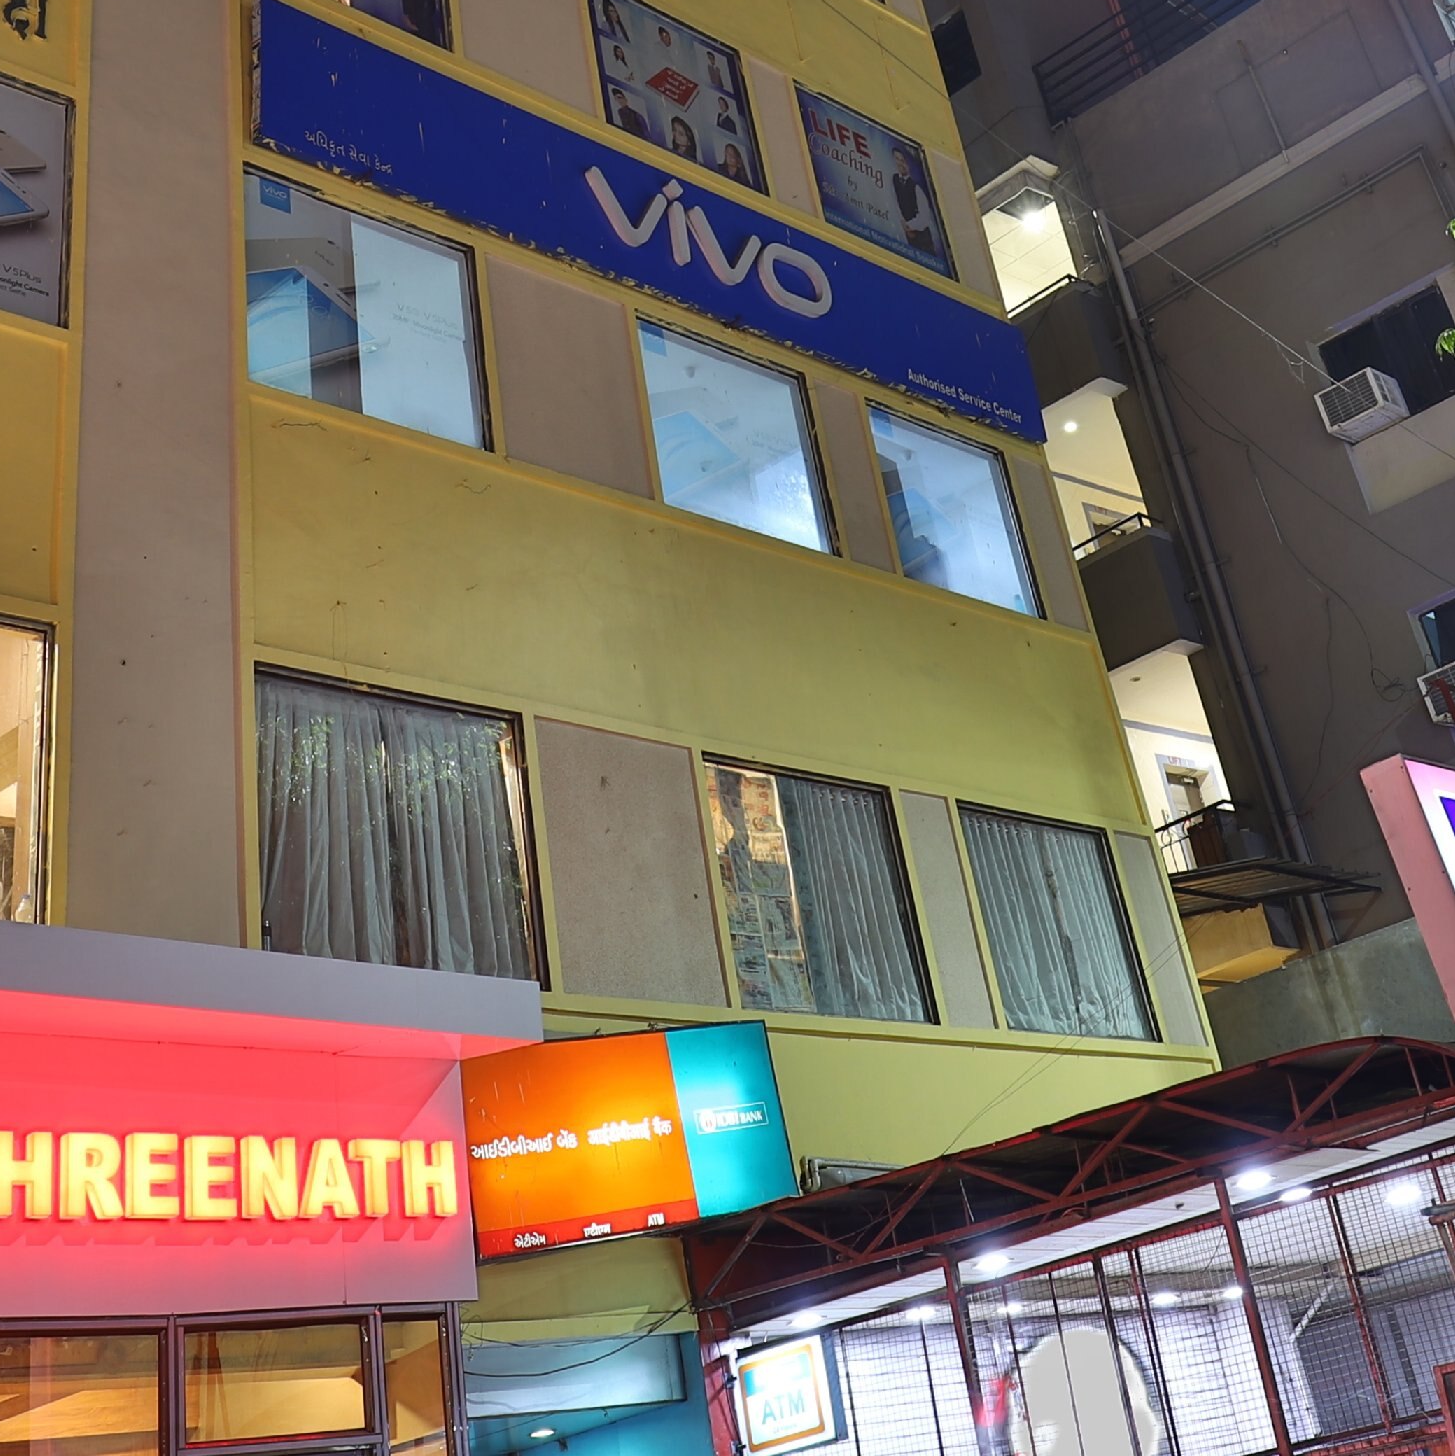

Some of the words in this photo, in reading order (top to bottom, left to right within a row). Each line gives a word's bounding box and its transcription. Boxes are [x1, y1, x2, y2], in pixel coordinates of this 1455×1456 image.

[809, 108, 871, 159] LIFE
[809, 132, 885, 189] Coaching
[584, 165, 834, 319] vivo
[908, 368, 957, 398] Authorised
[957, 387, 992, 412] Service
[992, 401, 1022, 424] Center
[647, 1212, 666, 1228] ATM
[761, 1389, 806, 1425] ATM
